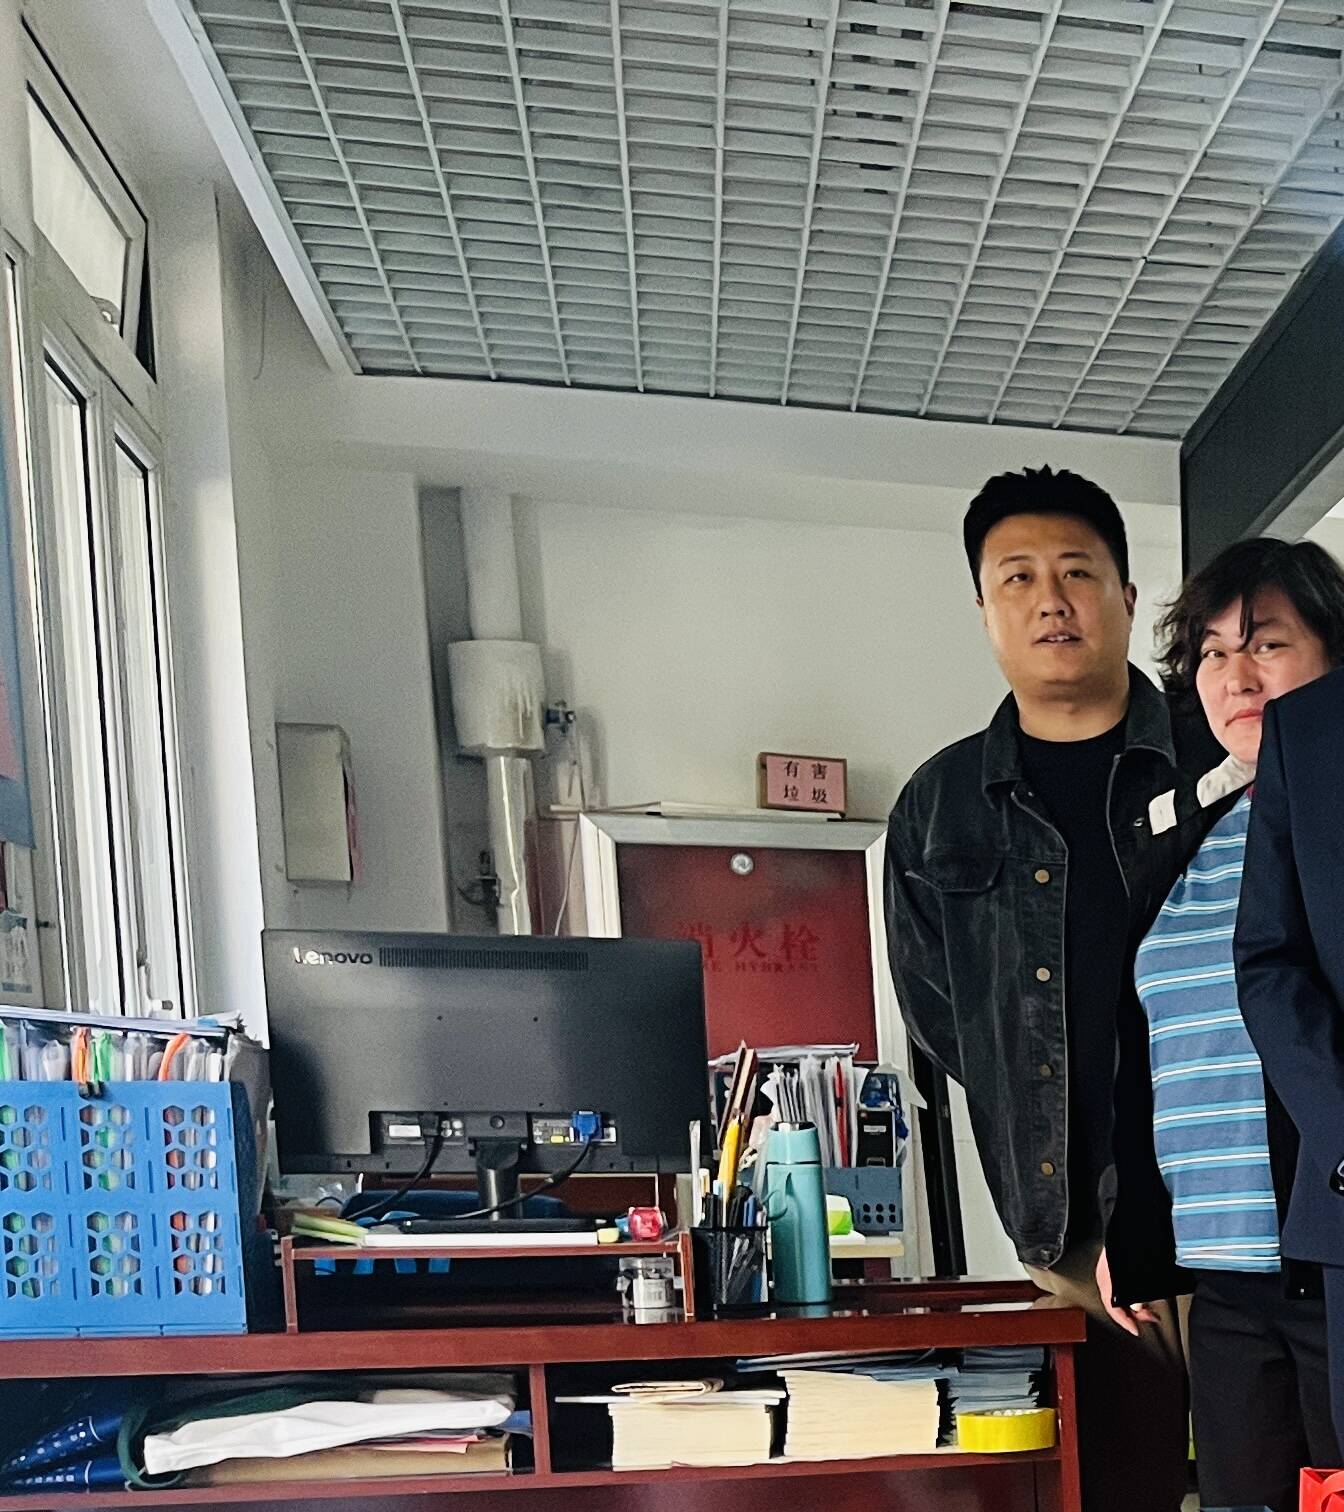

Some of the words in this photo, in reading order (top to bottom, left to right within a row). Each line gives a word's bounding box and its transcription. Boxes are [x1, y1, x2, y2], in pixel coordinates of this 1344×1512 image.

[783, 760, 827, 781] 有害
[784, 785, 827, 804] 垃圾
[292, 946, 373, 965] Lenovo
